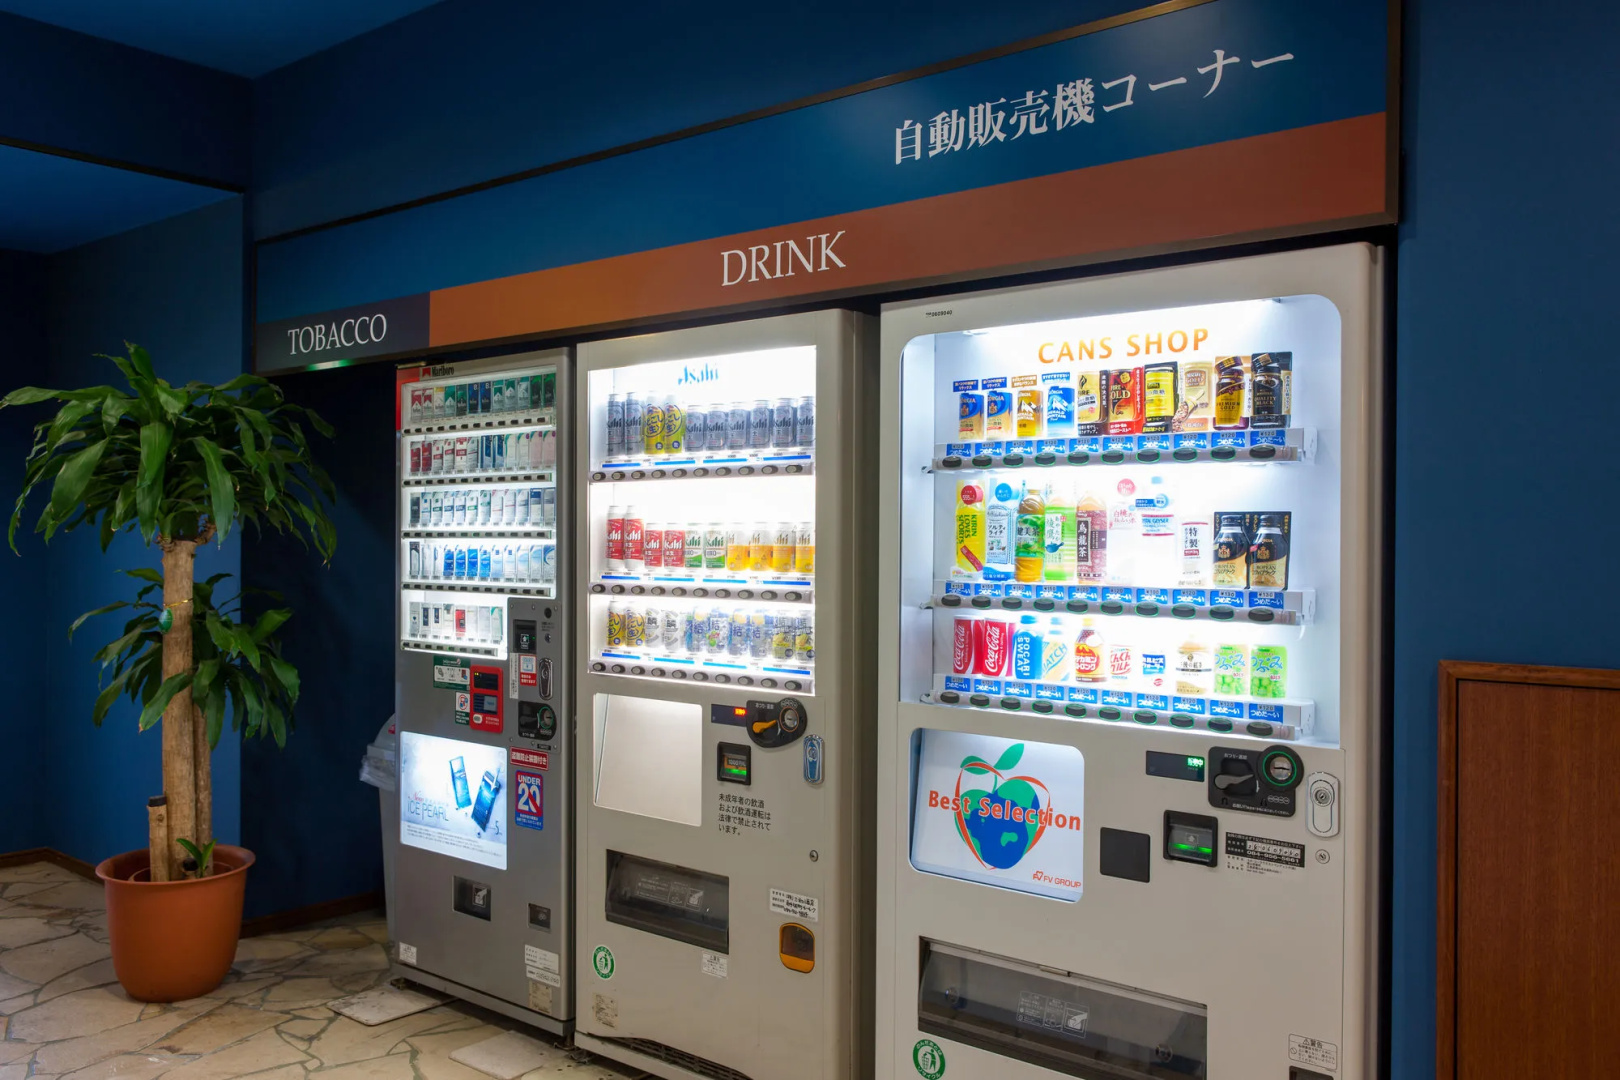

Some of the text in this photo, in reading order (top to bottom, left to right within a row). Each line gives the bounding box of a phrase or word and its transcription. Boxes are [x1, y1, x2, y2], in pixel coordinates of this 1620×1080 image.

[894, 49, 1295, 165] 自動販売機コーナー
[721, 231, 847, 286] DRINK
[288, 314, 387, 355] TOBACCO
[1038, 328, 1209, 364] CANS SHOP
[432, 366, 454, 376] Marlboro
[518, 775, 540, 785] UNDER
[518, 783, 540, 813] 20
[718, 793, 764, 808] 未成年者の飲酒
[718, 804, 771, 820] および飲酒運転は
[928, 790, 1081, 830] Best Selection
[718, 814, 771, 831] 法律で禁止されて
[719, 824, 741, 835] います。
[1055, 878, 1081, 888] GROUP
